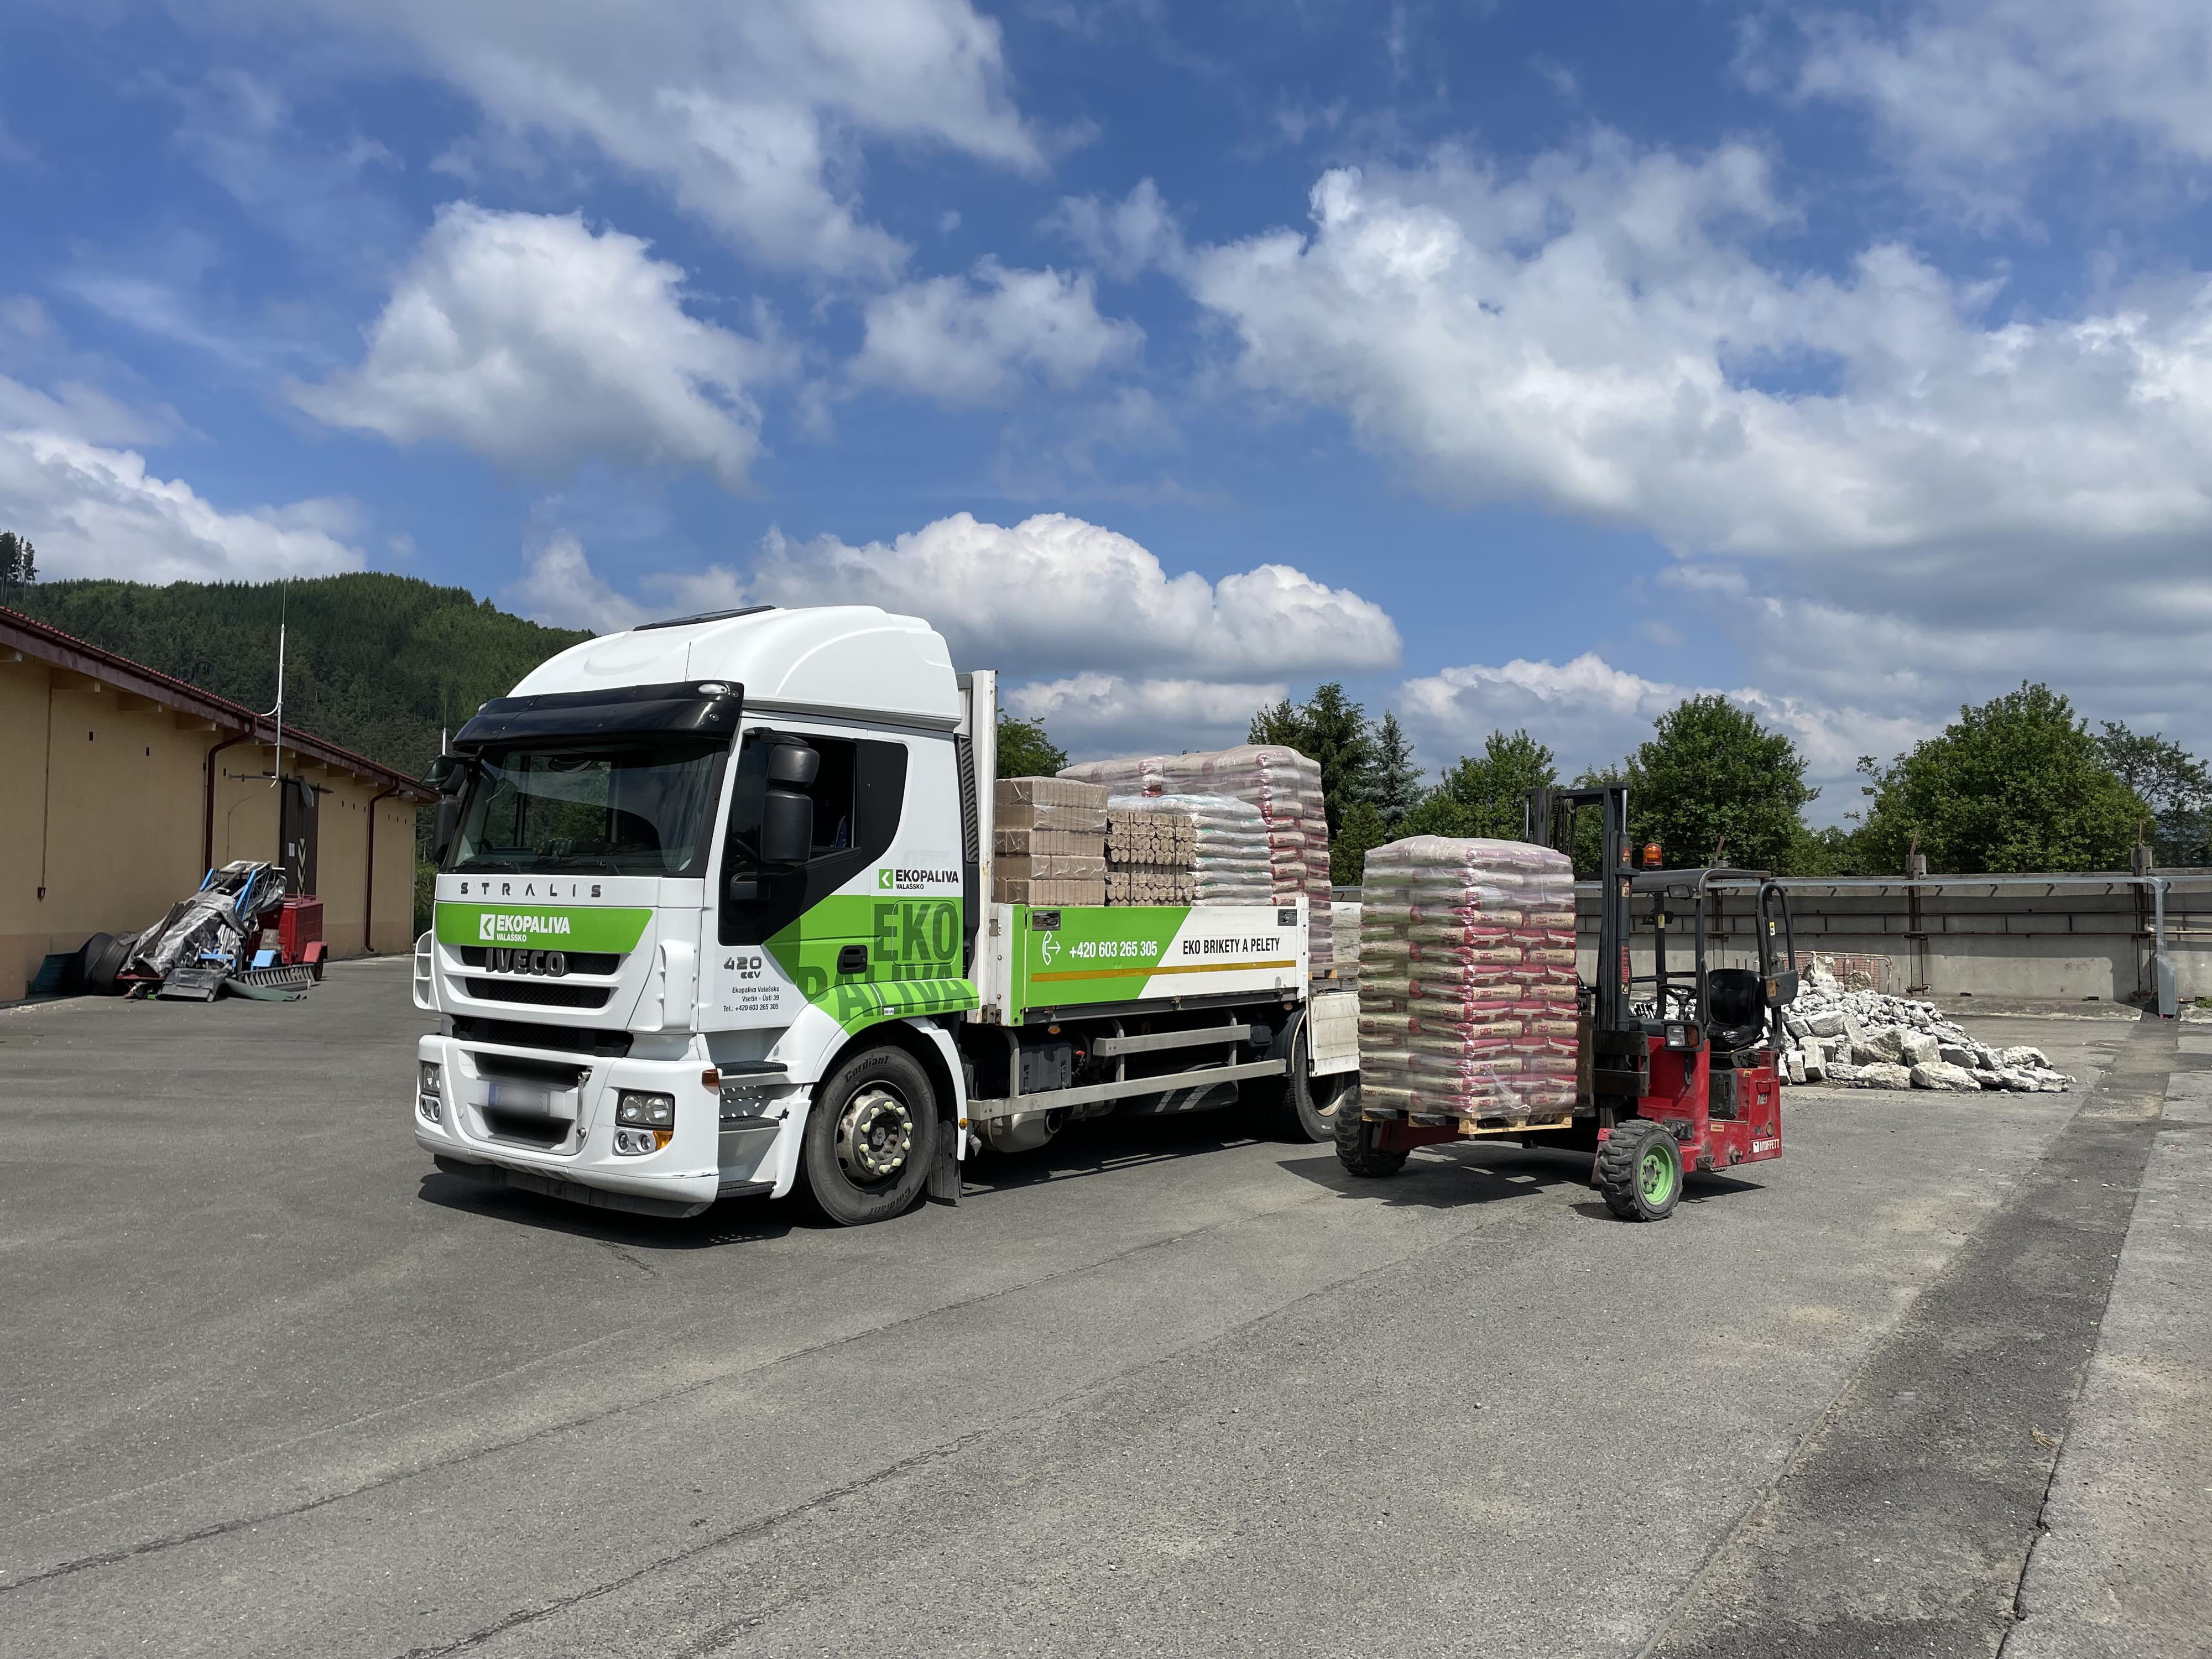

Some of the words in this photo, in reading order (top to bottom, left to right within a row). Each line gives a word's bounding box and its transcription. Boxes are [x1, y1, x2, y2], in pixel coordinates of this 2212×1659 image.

[895, 869, 959, 883] EKOPALIVA
[461, 882, 601, 898] STRALIS
[497, 915, 571, 934] EKOPALIVA
[873, 903, 958, 962] EKO
[497, 932, 526, 942] VALAŠSKO
[1070, 942, 1095, 958] +420
[1098, 942, 1117, 957] 603
[1120, 941, 1138, 957] 265
[1140, 941, 1157, 956] 305
[1183, 940, 1201, 955] EKO
[1203, 939, 1240, 954] BRIKETY
[1242, 939, 1249, 952] A
[1251, 937, 1280, 952] PELETY
[486, 947, 565, 977] IVECO
[723, 956, 762, 970] 420
[844, 1055, 889, 1083] Cordiant
[1760, 1139, 1780, 1151] MOFFETT
